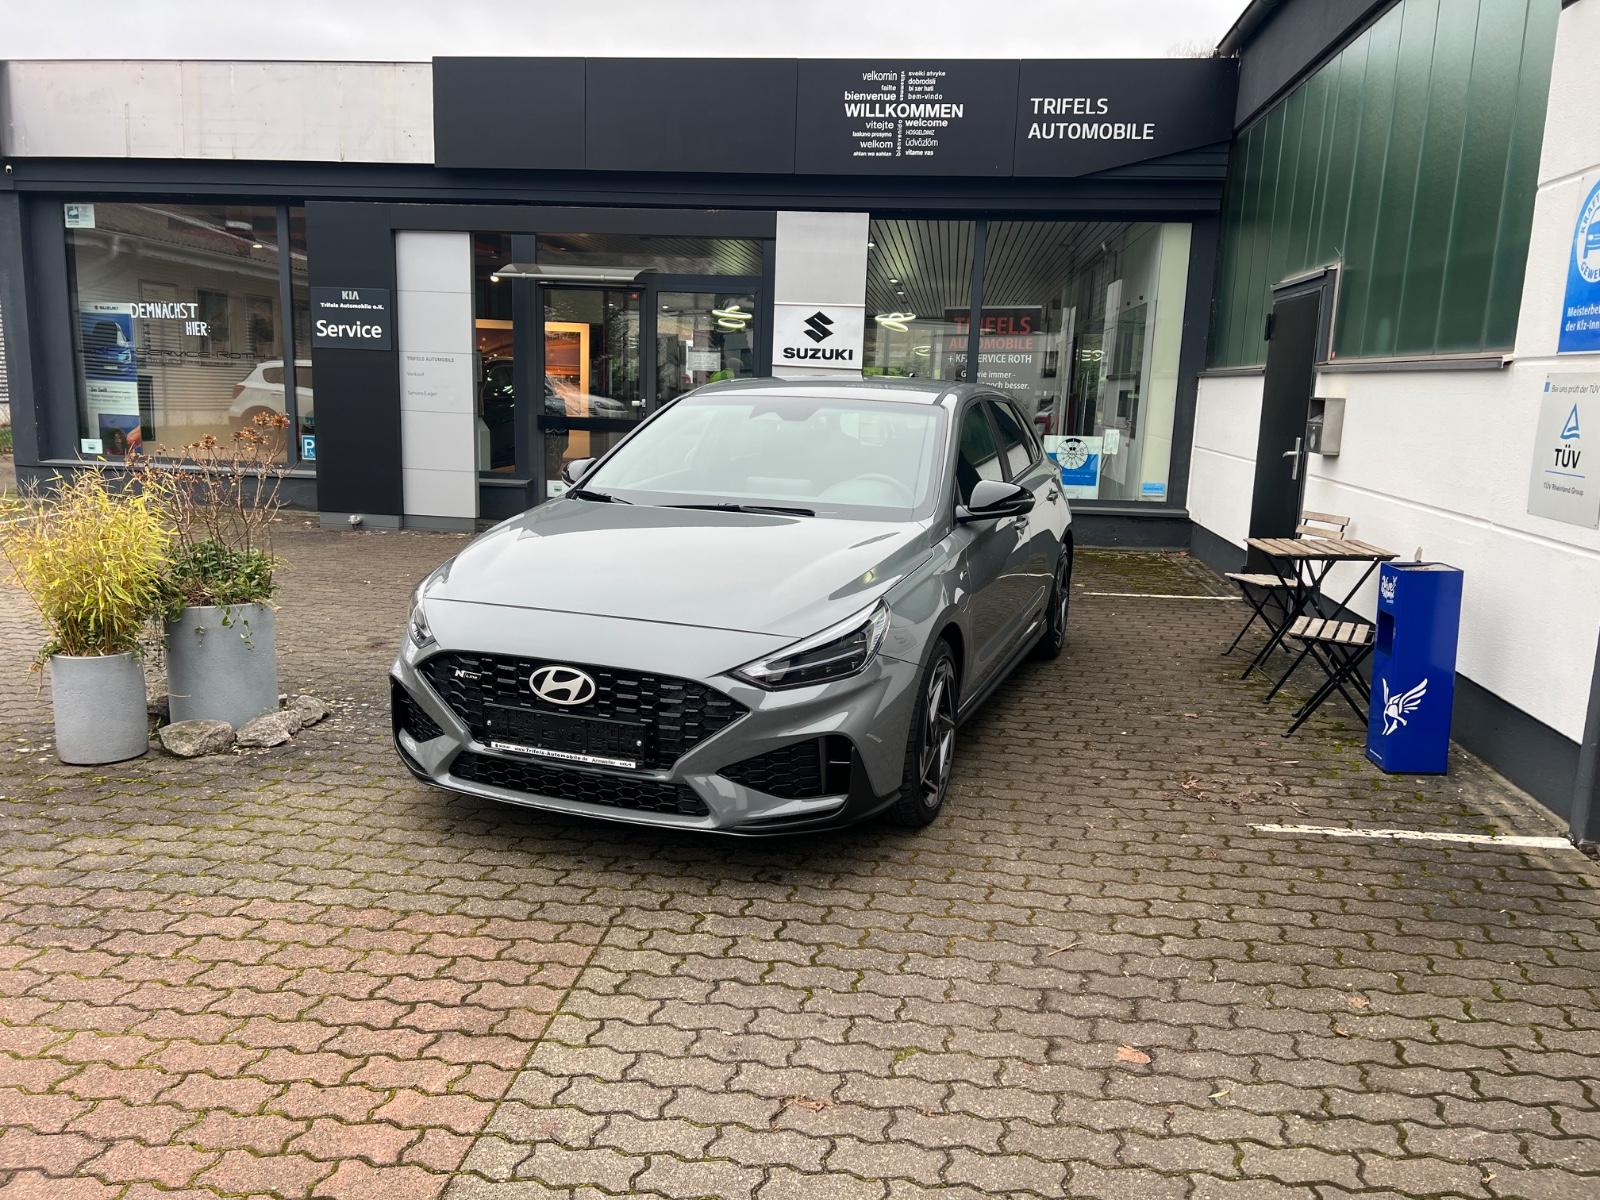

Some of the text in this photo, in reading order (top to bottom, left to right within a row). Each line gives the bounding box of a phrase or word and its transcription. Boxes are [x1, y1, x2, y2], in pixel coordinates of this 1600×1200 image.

[862, 70, 897, 81] velkomin
[844, 90, 897, 100] bienvenue
[844, 103, 964, 118] WILLKOMMEN
[1030, 98, 1108, 115] TRIFELS
[865, 120, 894, 131] vitejte
[905, 118, 948, 127] welcome
[1027, 122, 1155, 140] AUTOMOBILE
[860, 139, 893, 148] welkom
[341, 290, 360, 300] KIA
[131, 301, 198, 319] DEMNÄCHST
[185, 321, 211, 336] HIER:
[316, 319, 382, 338] Service
[783, 347, 853, 360] SUZUKI
[1007, 355, 1032, 363] ROTH
[304, 439, 315, 456] P
[1555, 443, 1581, 469] TÜV
[454, 670, 465, 678] N
